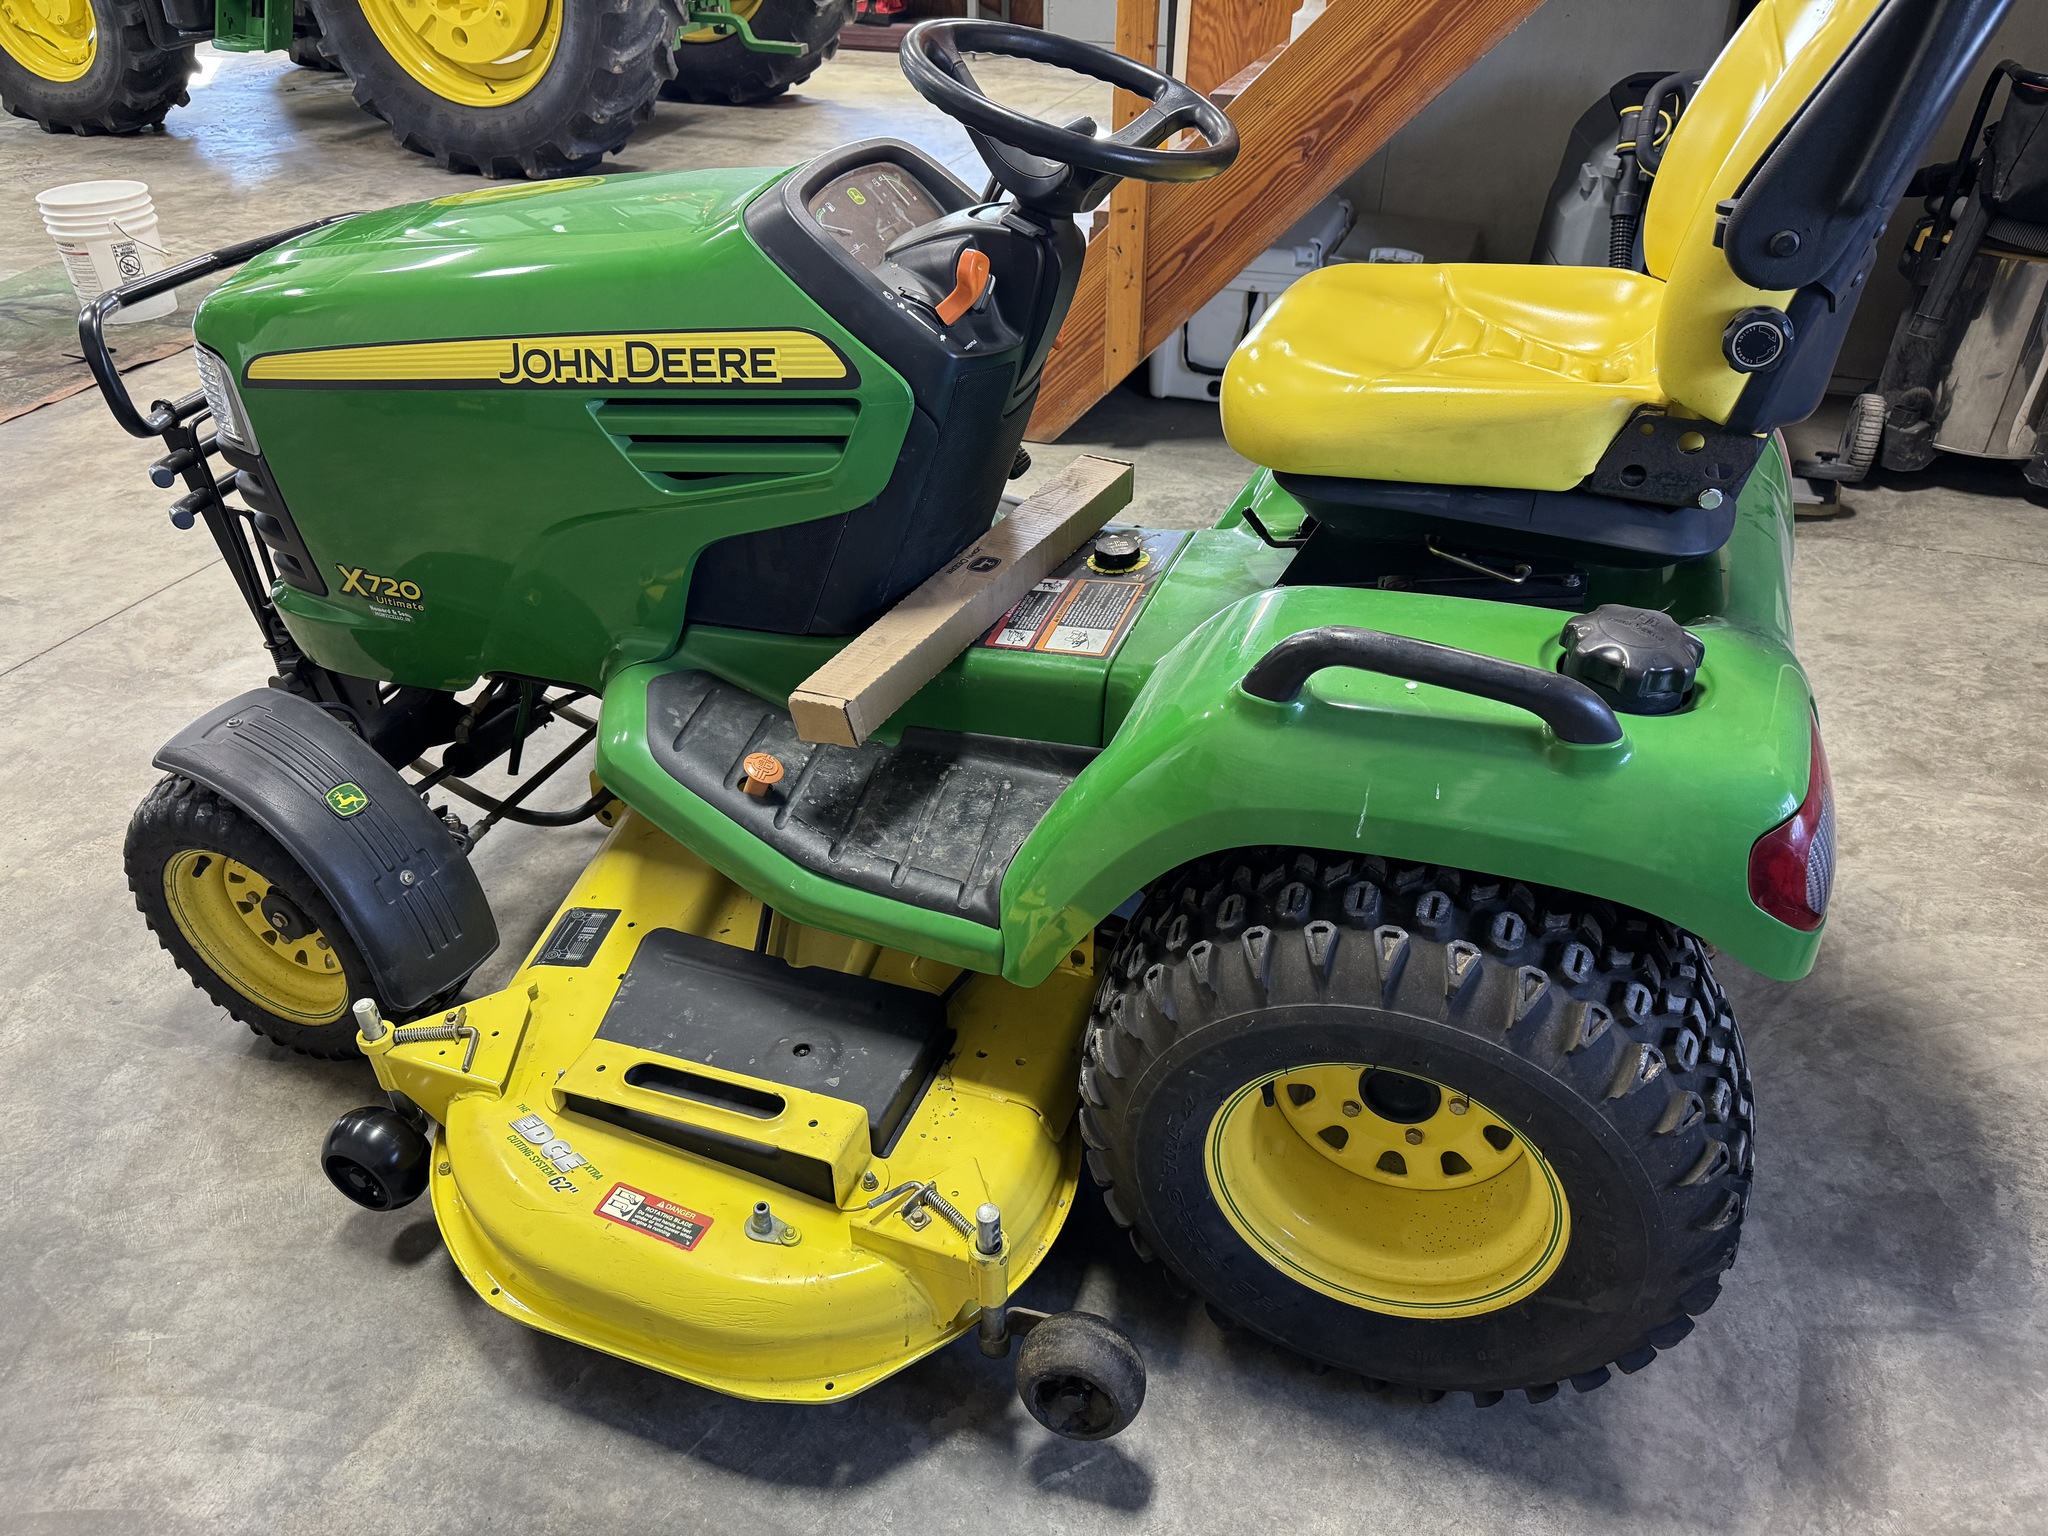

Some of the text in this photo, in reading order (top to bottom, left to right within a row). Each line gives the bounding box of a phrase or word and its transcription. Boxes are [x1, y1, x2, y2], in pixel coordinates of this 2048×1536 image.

[1738, 326, 1756, 343] ADJUST
[499, 340, 778, 380] JOHN DEERE
[336, 564, 422, 600] X720
[376, 596, 425, 612] Ultimate
[516, 1103, 531, 1114] THE
[508, 1113, 604, 1181] EDGE XTRA
[506, 1134, 579, 1194] CUTTING SYSTEM 62"
[645, 1206, 694, 1228] ROTATING BLADE
[665, 1203, 697, 1220] DANGER
[634, 1214, 648, 1223] under
[664, 1224, 681, 1235] mower
[680, 1230, 693, 1240] when
[661, 1217, 676, 1228] hands
[682, 1226, 692, 1234] feet
